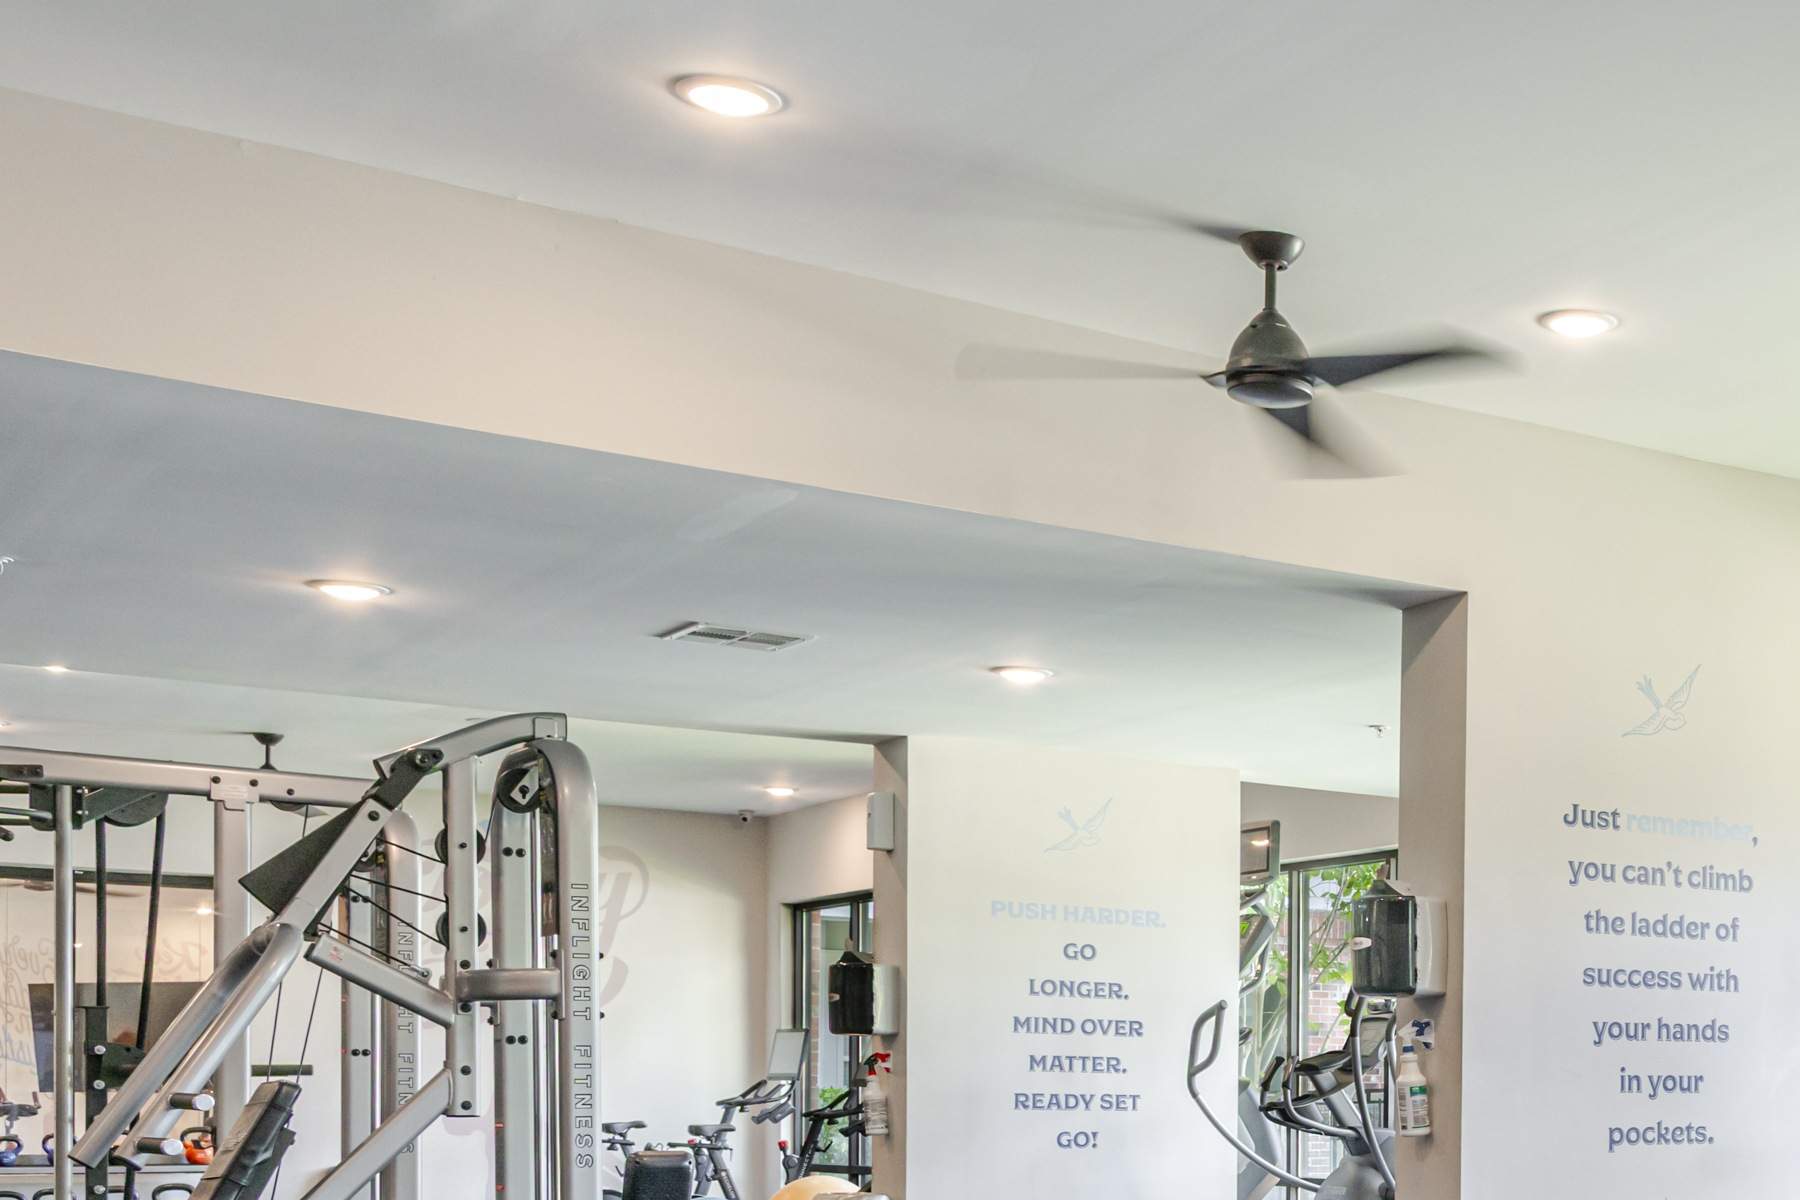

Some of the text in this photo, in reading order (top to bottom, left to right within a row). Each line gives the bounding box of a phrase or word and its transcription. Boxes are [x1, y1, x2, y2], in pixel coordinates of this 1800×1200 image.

[1563, 804, 1759, 847] Just remember,
[1568, 858, 1753, 892] you can’t climb
[991, 900, 1166, 928] PUSH HARDER.
[1584, 909, 1740, 942] the ladder of
[1063, 943, 1097, 961] GO
[1028, 980, 1130, 1000] LONGER.
[1582, 965, 1739, 992] success with
[397, 921, 416, 1155] INFLHT FITNS
[570, 883, 595, 1169] INFLIGHT FITNESS
[1013, 1016, 1144, 1037] MIND OVER
[1592, 1017, 1729, 1046] your hands
[1028, 1054, 1127, 1074] MATTER.
[1619, 1067, 1704, 1099] in your
[1014, 1093, 1140, 1112] READY SET
[1056, 1131, 1098, 1149] GO!
[1608, 1121, 1714, 1153] pockets.
